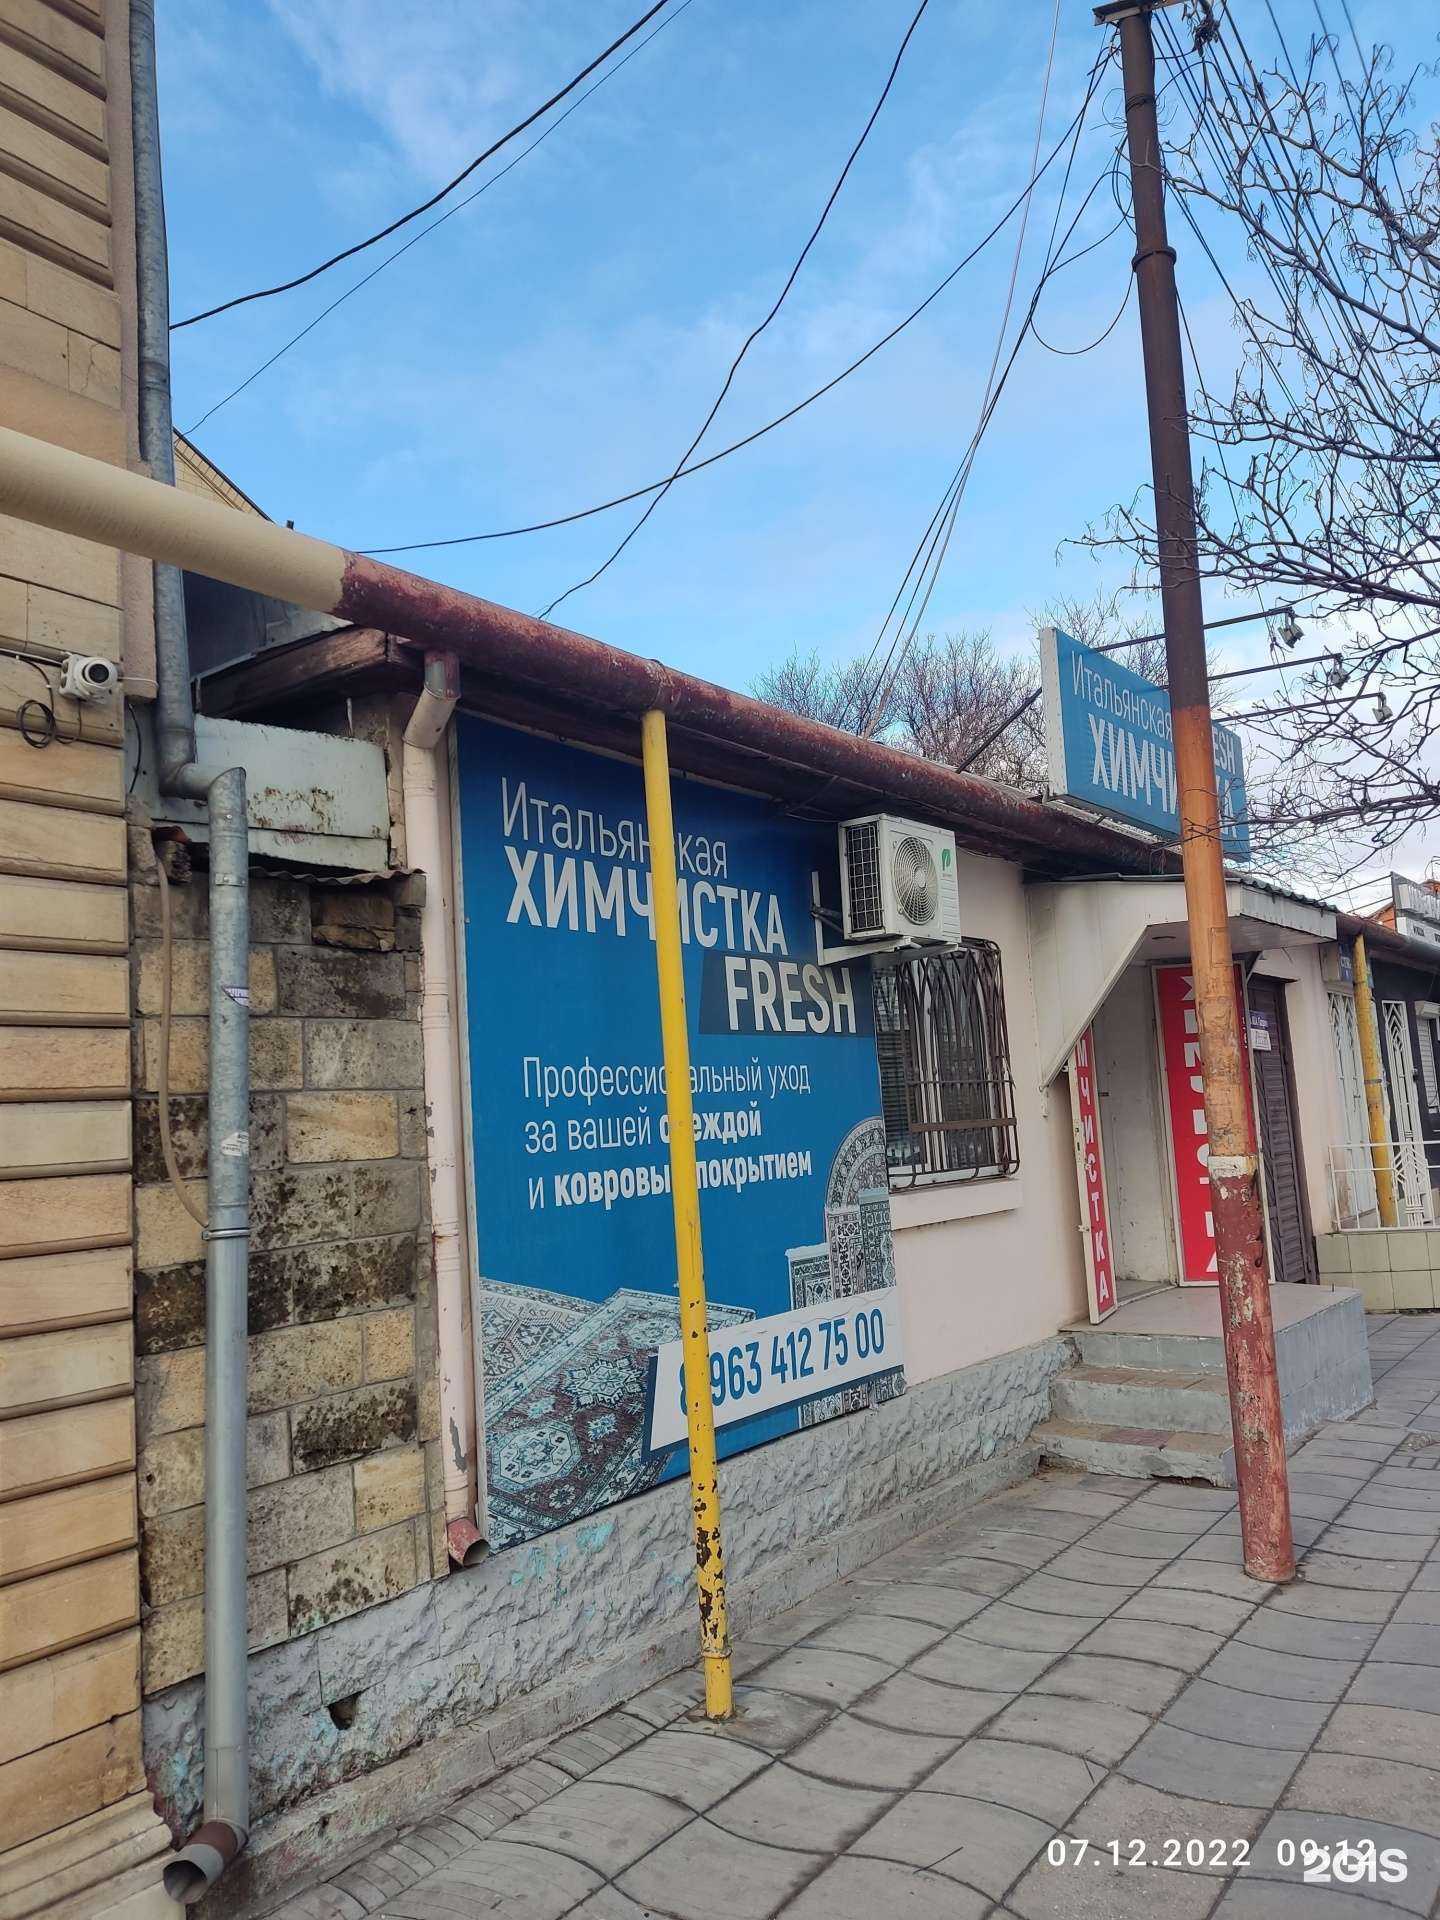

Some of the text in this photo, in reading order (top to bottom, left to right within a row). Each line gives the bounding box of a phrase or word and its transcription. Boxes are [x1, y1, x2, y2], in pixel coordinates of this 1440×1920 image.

[1071, 650, 1173, 742] Итальянская
[501, 776, 729, 879] Итальянкая
[723, 955, 858, 1034] FRESH
[522, 1055, 812, 1107] Профессиоальный уход
[524, 1100, 763, 1155] за вашей оеждой
[554, 1163, 673, 1211] ковровы
[695, 1149, 813, 1193] покрытием
[710, 1340, 763, 1407] 963
[770, 1326, 815, 1385] 412
[818, 1316, 849, 1371] 75
[854, 1307, 886, 1360] 00
